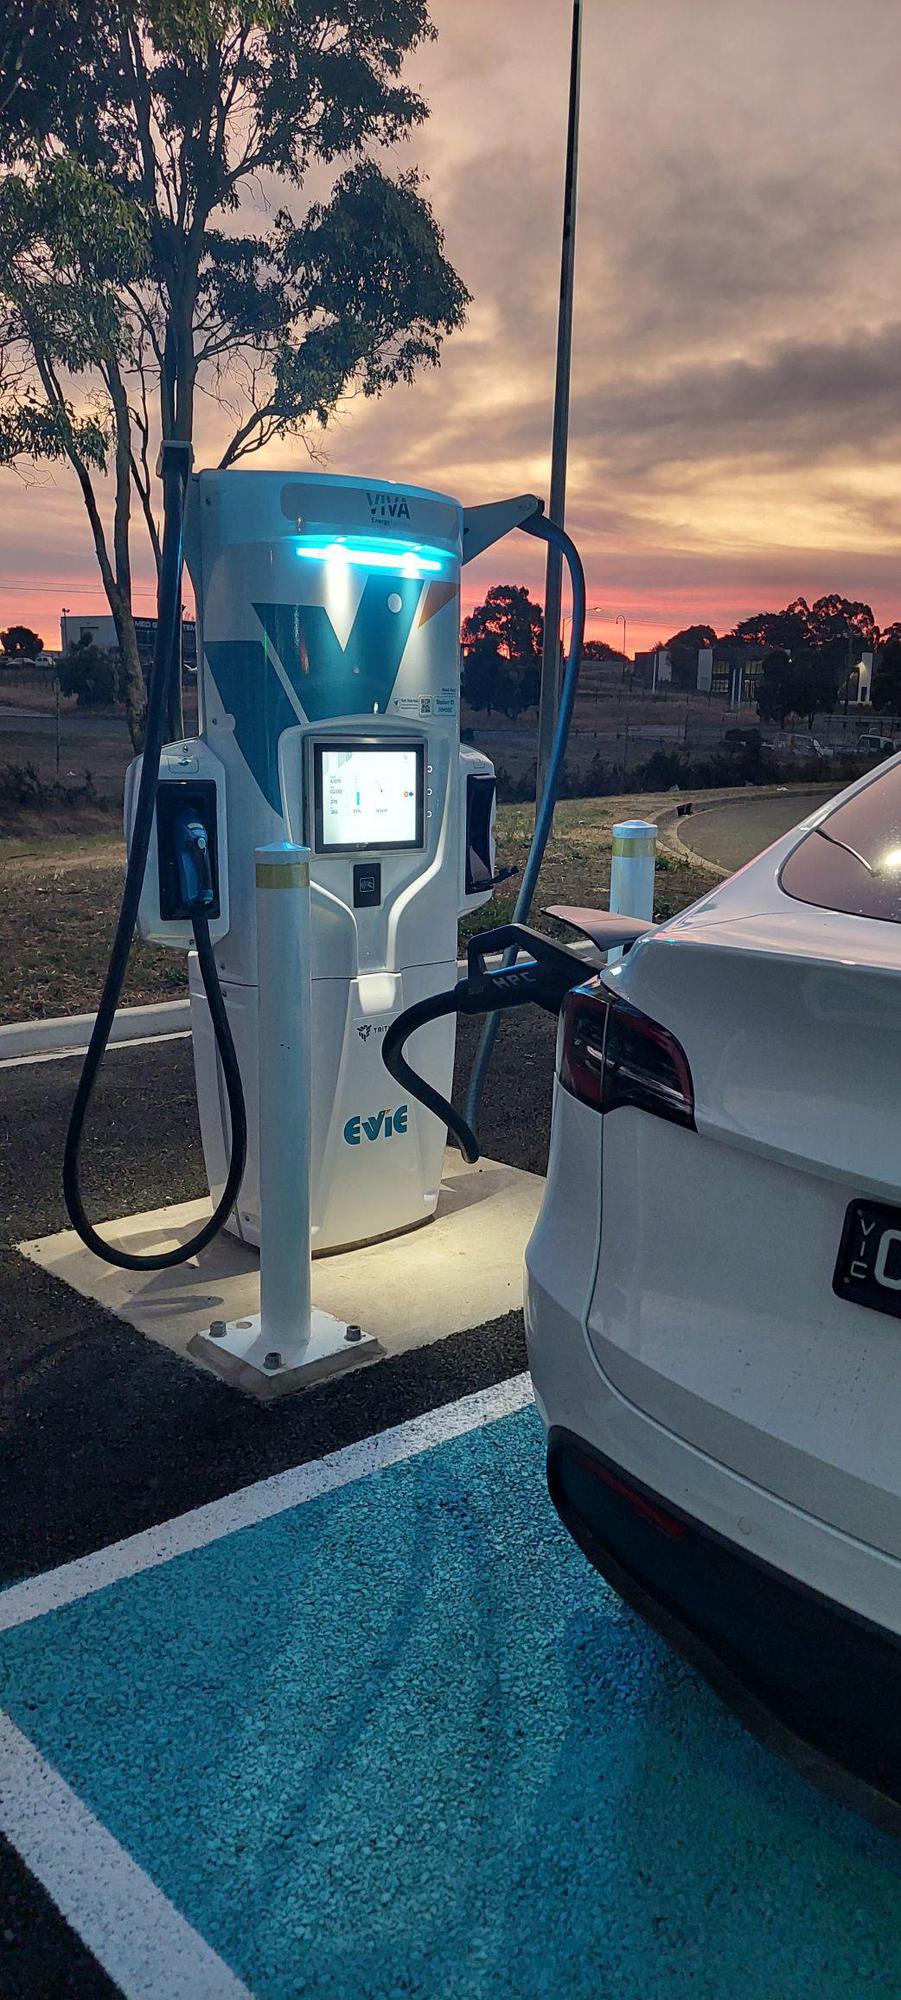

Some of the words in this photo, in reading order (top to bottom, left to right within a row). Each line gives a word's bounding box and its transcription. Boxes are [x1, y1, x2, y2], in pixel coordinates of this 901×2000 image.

[366, 492, 411, 520] VIVA
[492, 972, 537, 989] HPC
[851, 1218, 876, 1279] VIC
